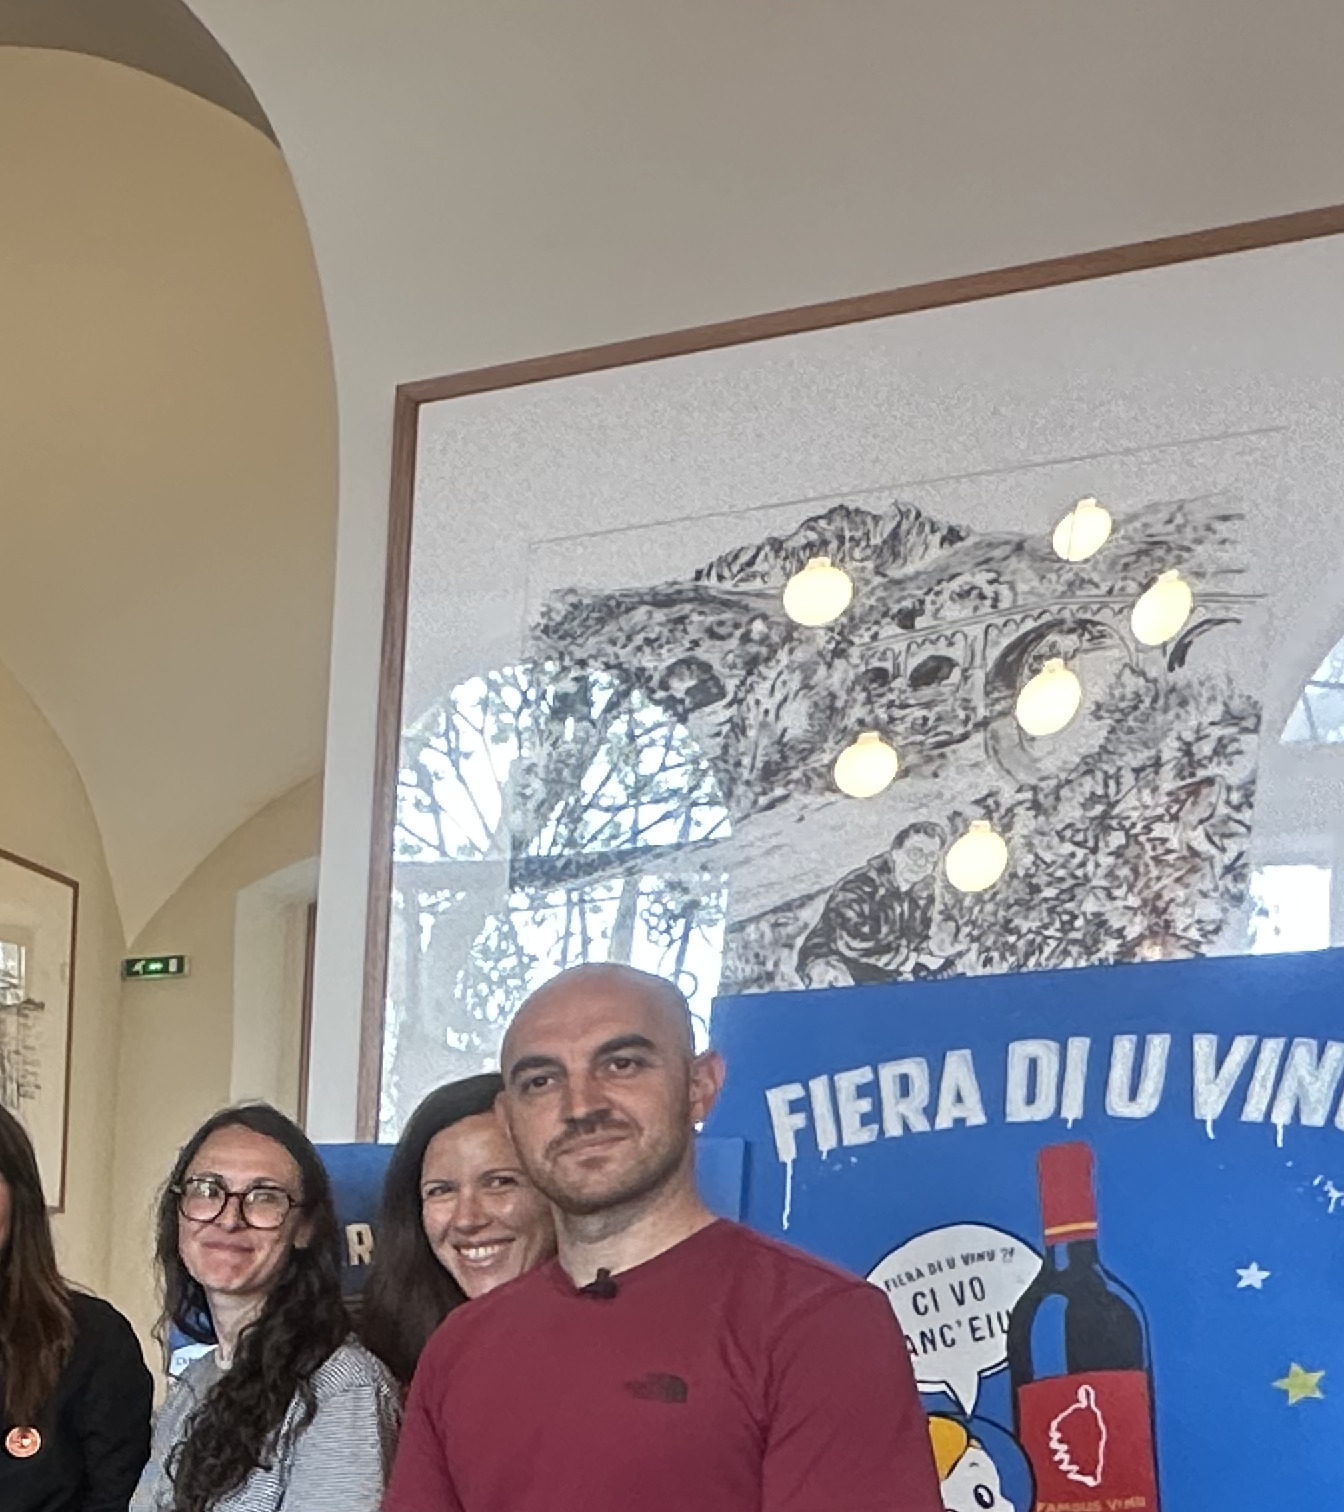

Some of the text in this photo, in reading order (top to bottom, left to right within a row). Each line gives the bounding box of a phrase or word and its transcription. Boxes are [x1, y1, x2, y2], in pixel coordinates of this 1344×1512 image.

[766, 1034, 1344, 1163] FIERA DI U VIN
[884, 1267, 926, 1292] FIERA
[926, 1260, 944, 1276] DI
[945, 1256, 956, 1270] U
[960, 1249, 996, 1266] VINU
[912, 1276, 986, 1316] CI VO
